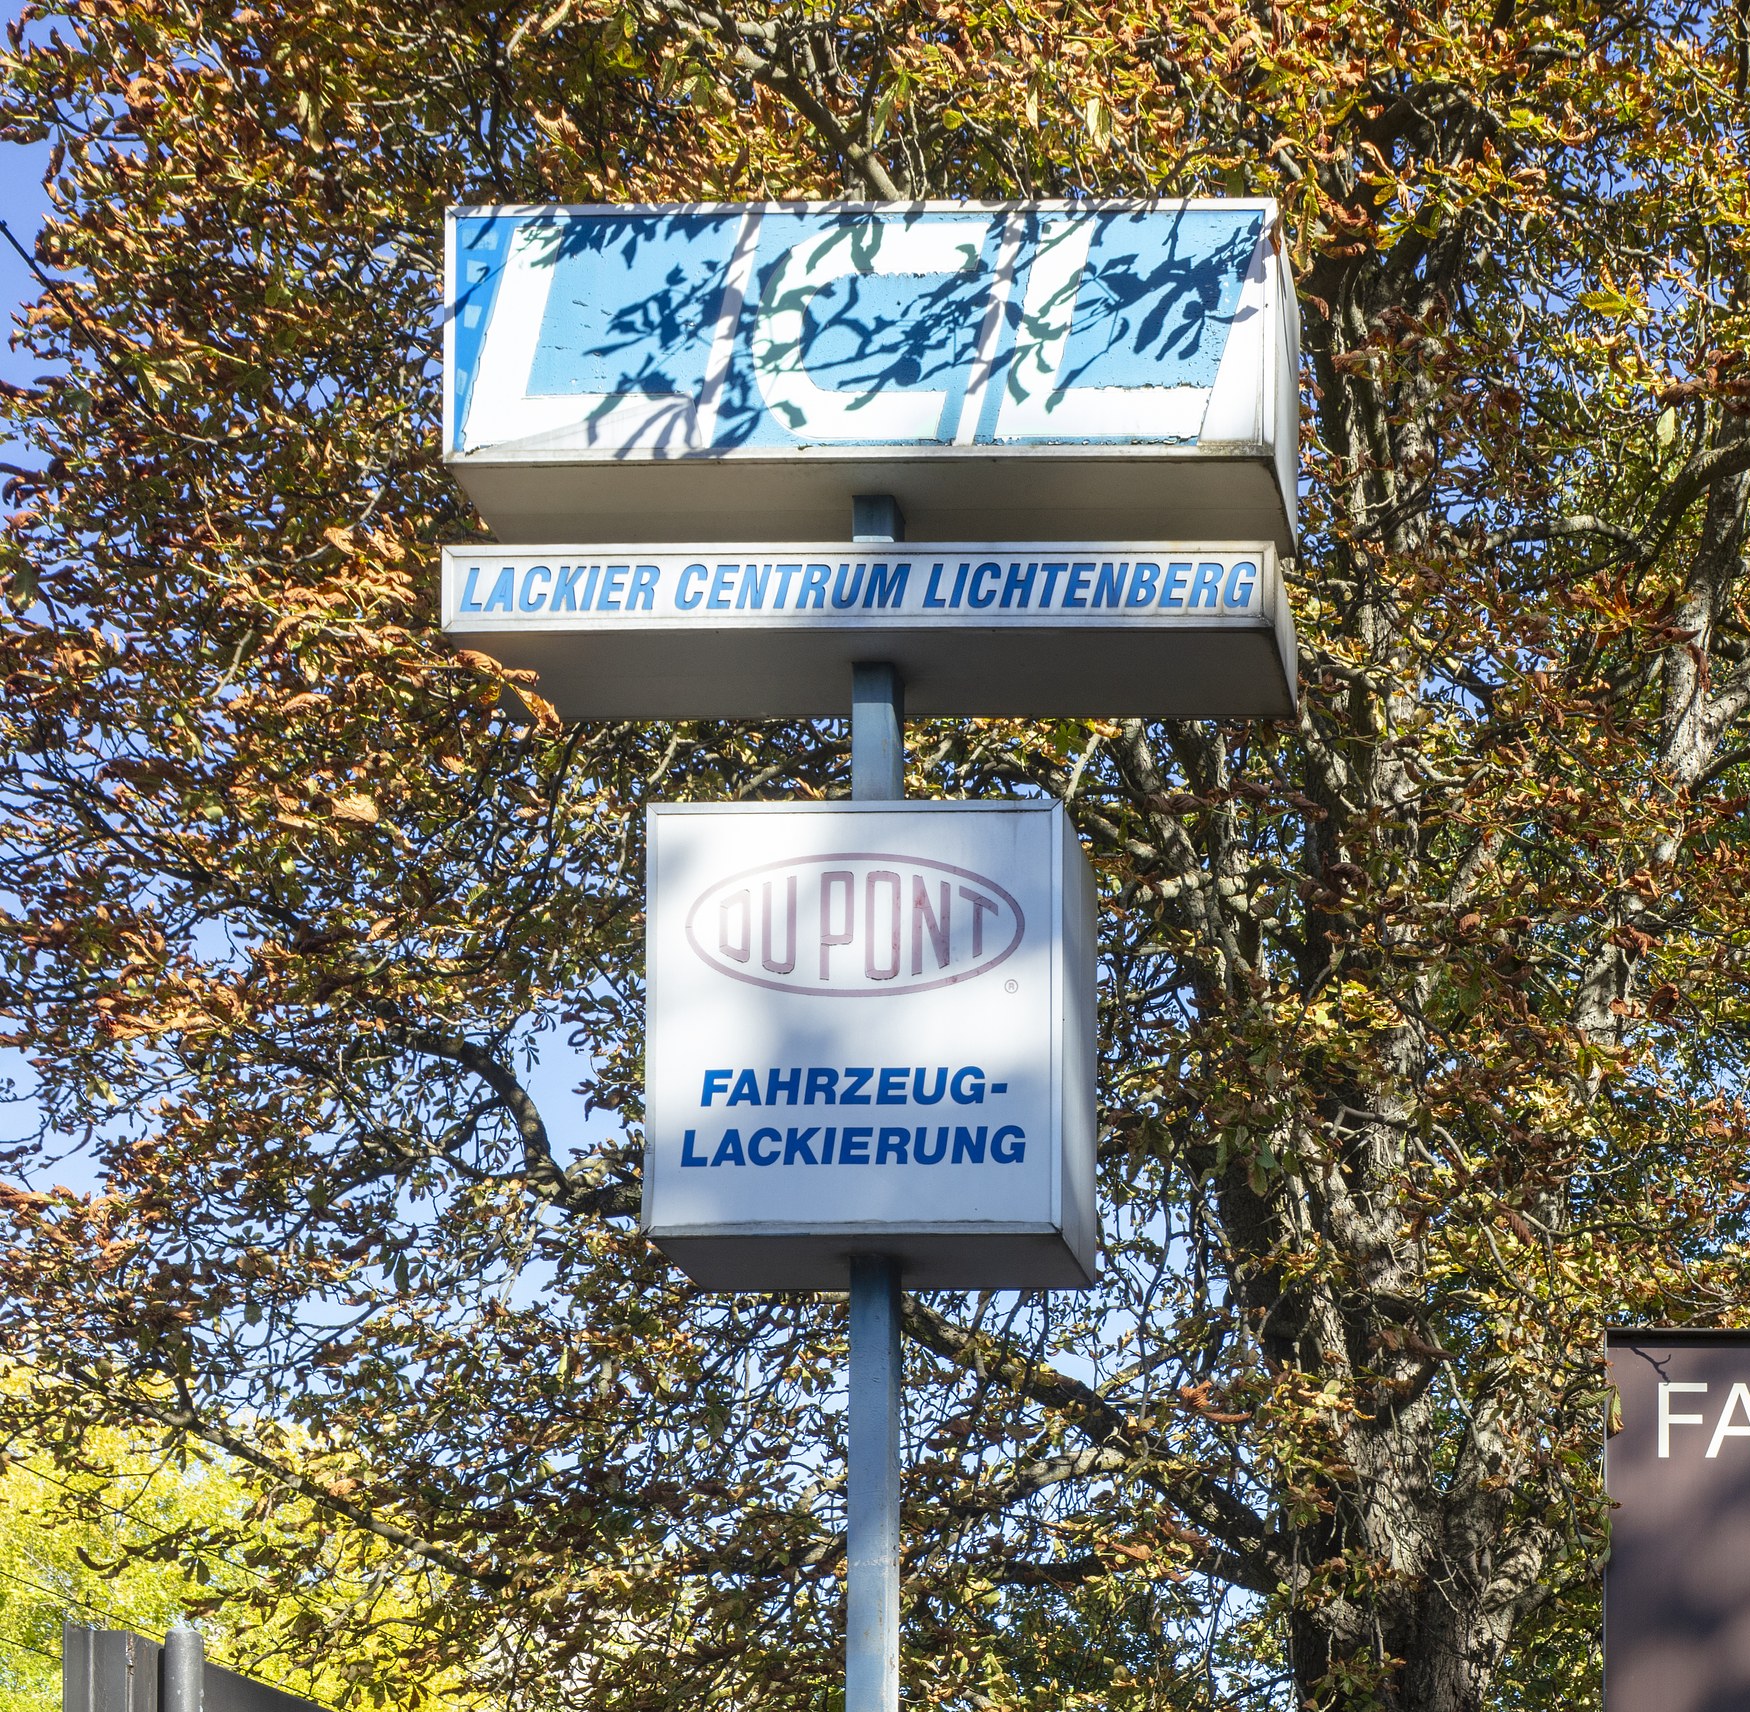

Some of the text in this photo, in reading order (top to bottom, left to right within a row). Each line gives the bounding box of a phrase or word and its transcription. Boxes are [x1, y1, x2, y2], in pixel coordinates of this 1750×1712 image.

[459, 561, 1258, 613] LACKIER CENTRUM LICHTENBERG
[700, 1065, 1008, 1107] FAHRZEUG-
[680, 1125, 1026, 1168] LACKIERUNG
